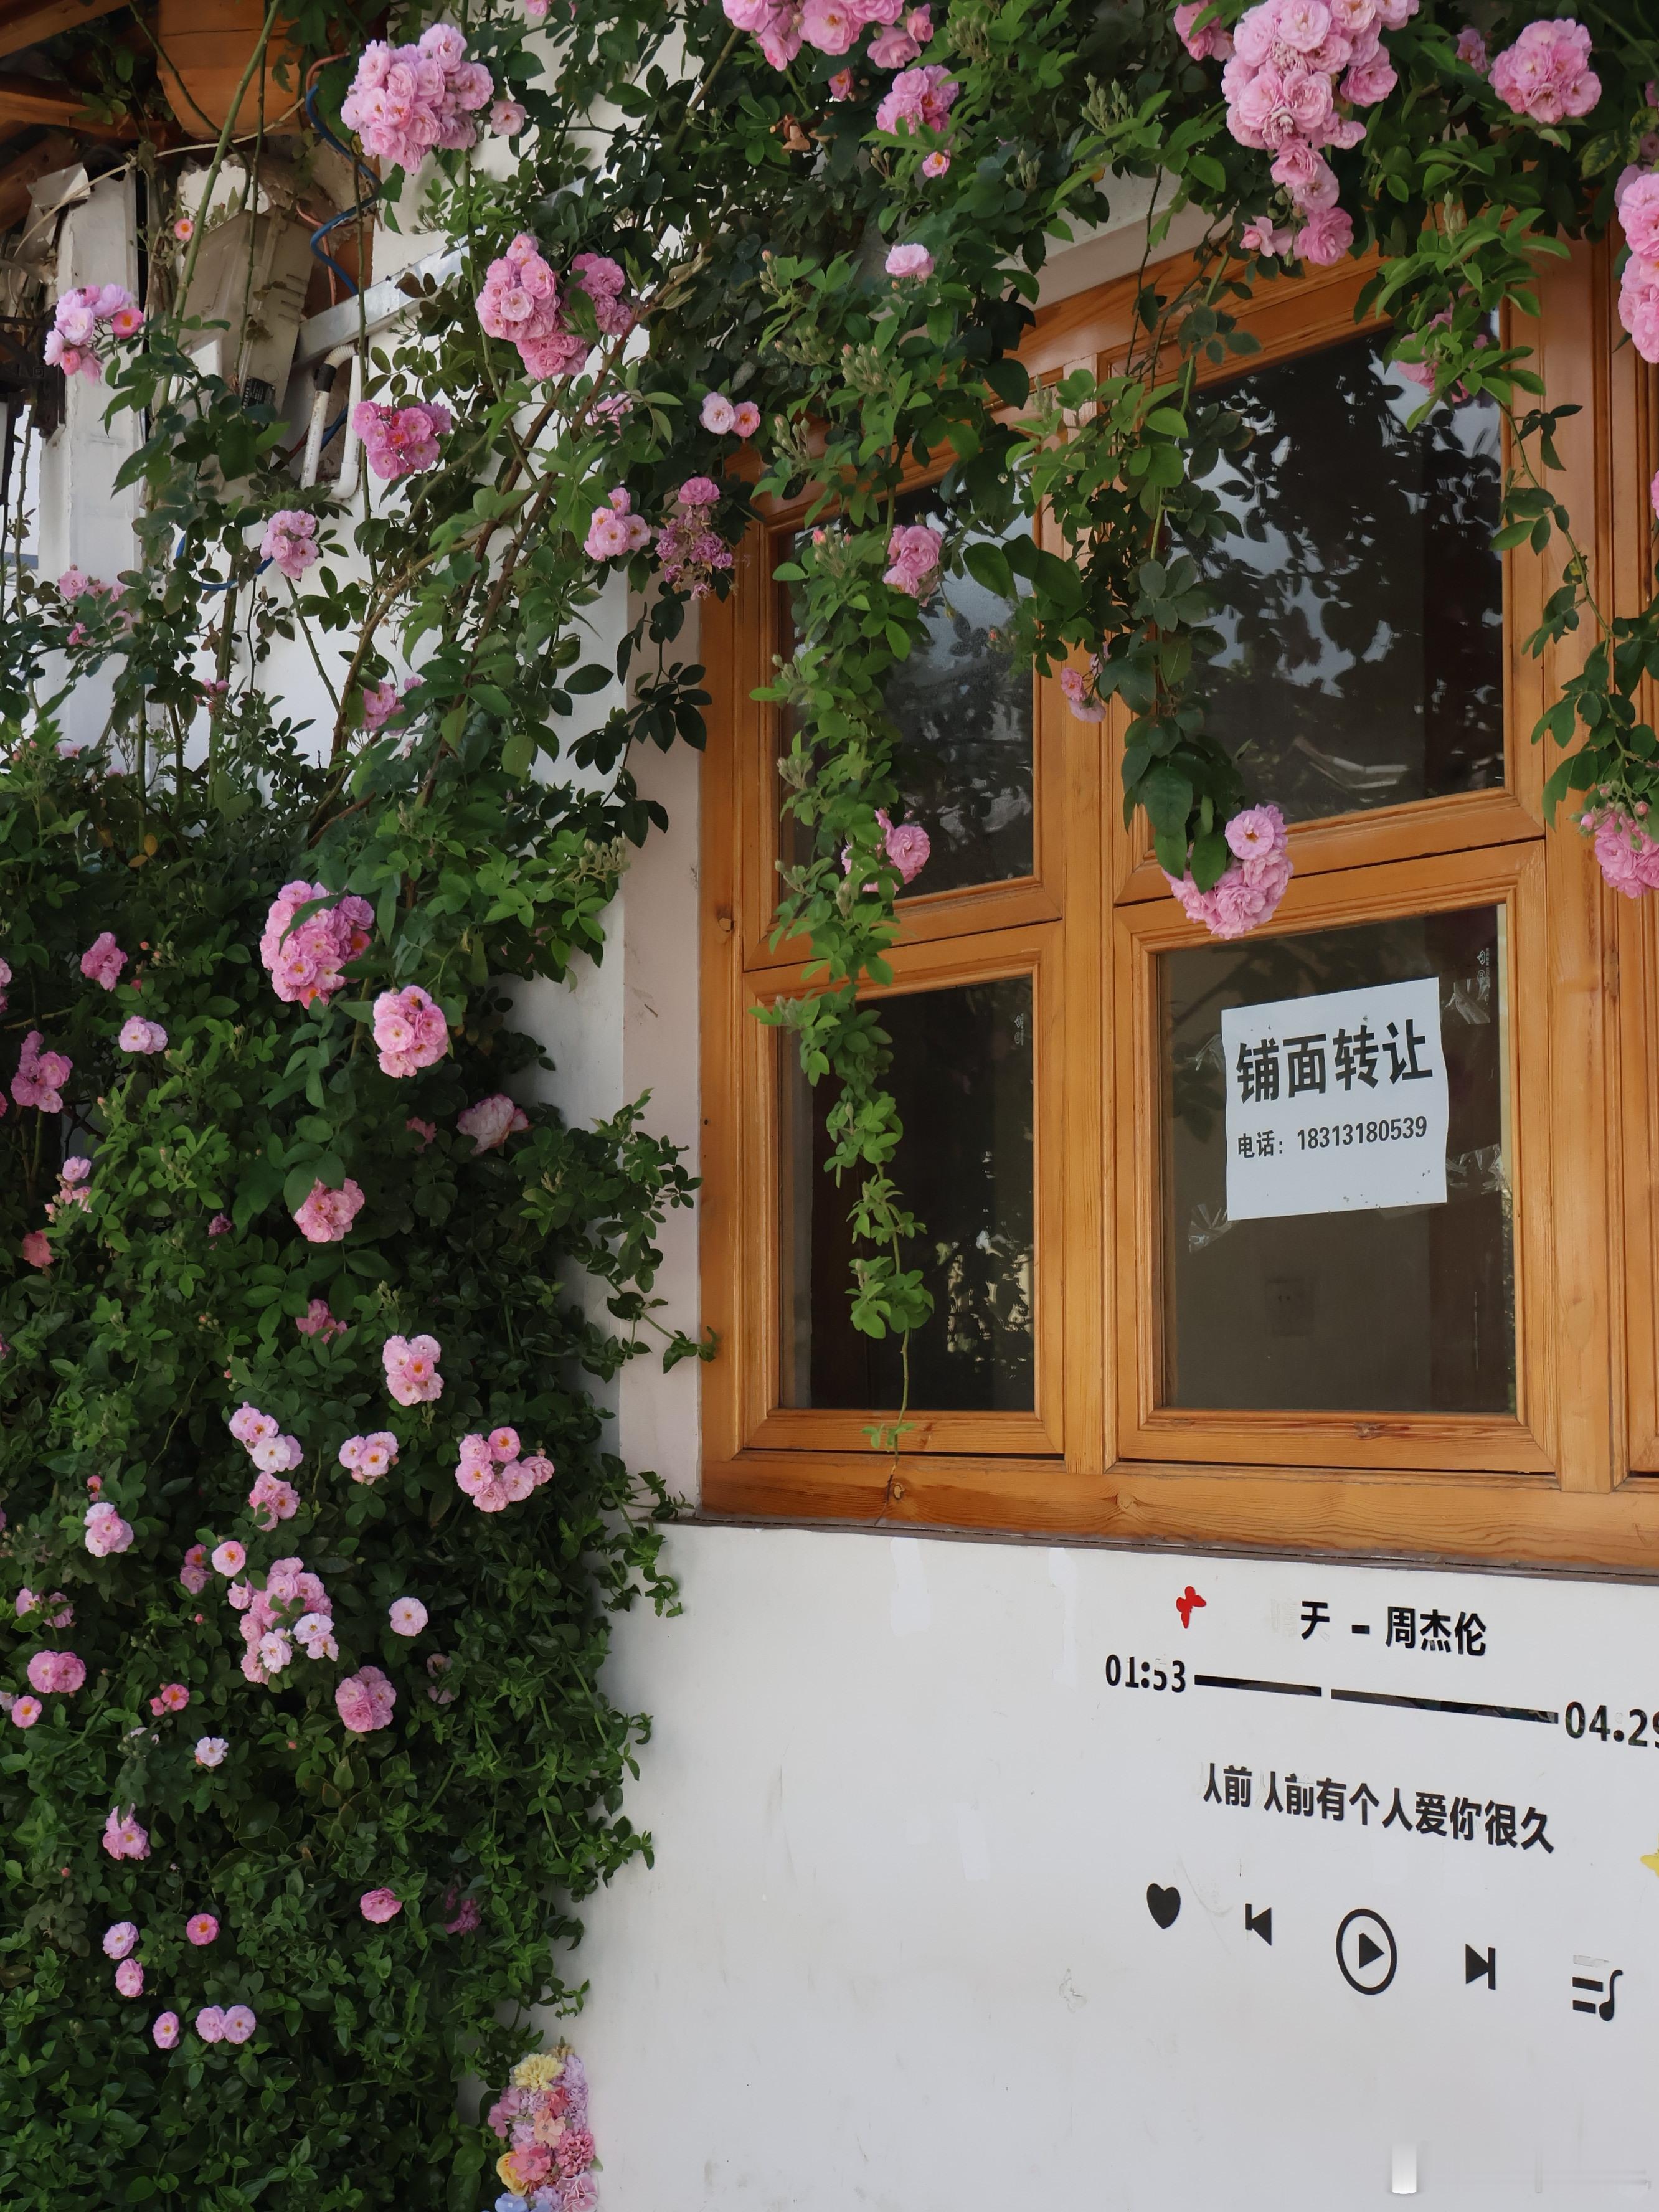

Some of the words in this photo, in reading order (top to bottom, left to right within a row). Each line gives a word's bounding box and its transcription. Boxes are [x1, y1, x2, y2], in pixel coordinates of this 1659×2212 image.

[1236, 1018, 1434, 1104] 铺面转让
[1297, 1115, 1427, 1151] 18313180539
[1384, 1606, 1487, 1657] 周杰伦
[1105, 1654, 1186, 1693] 01:53
